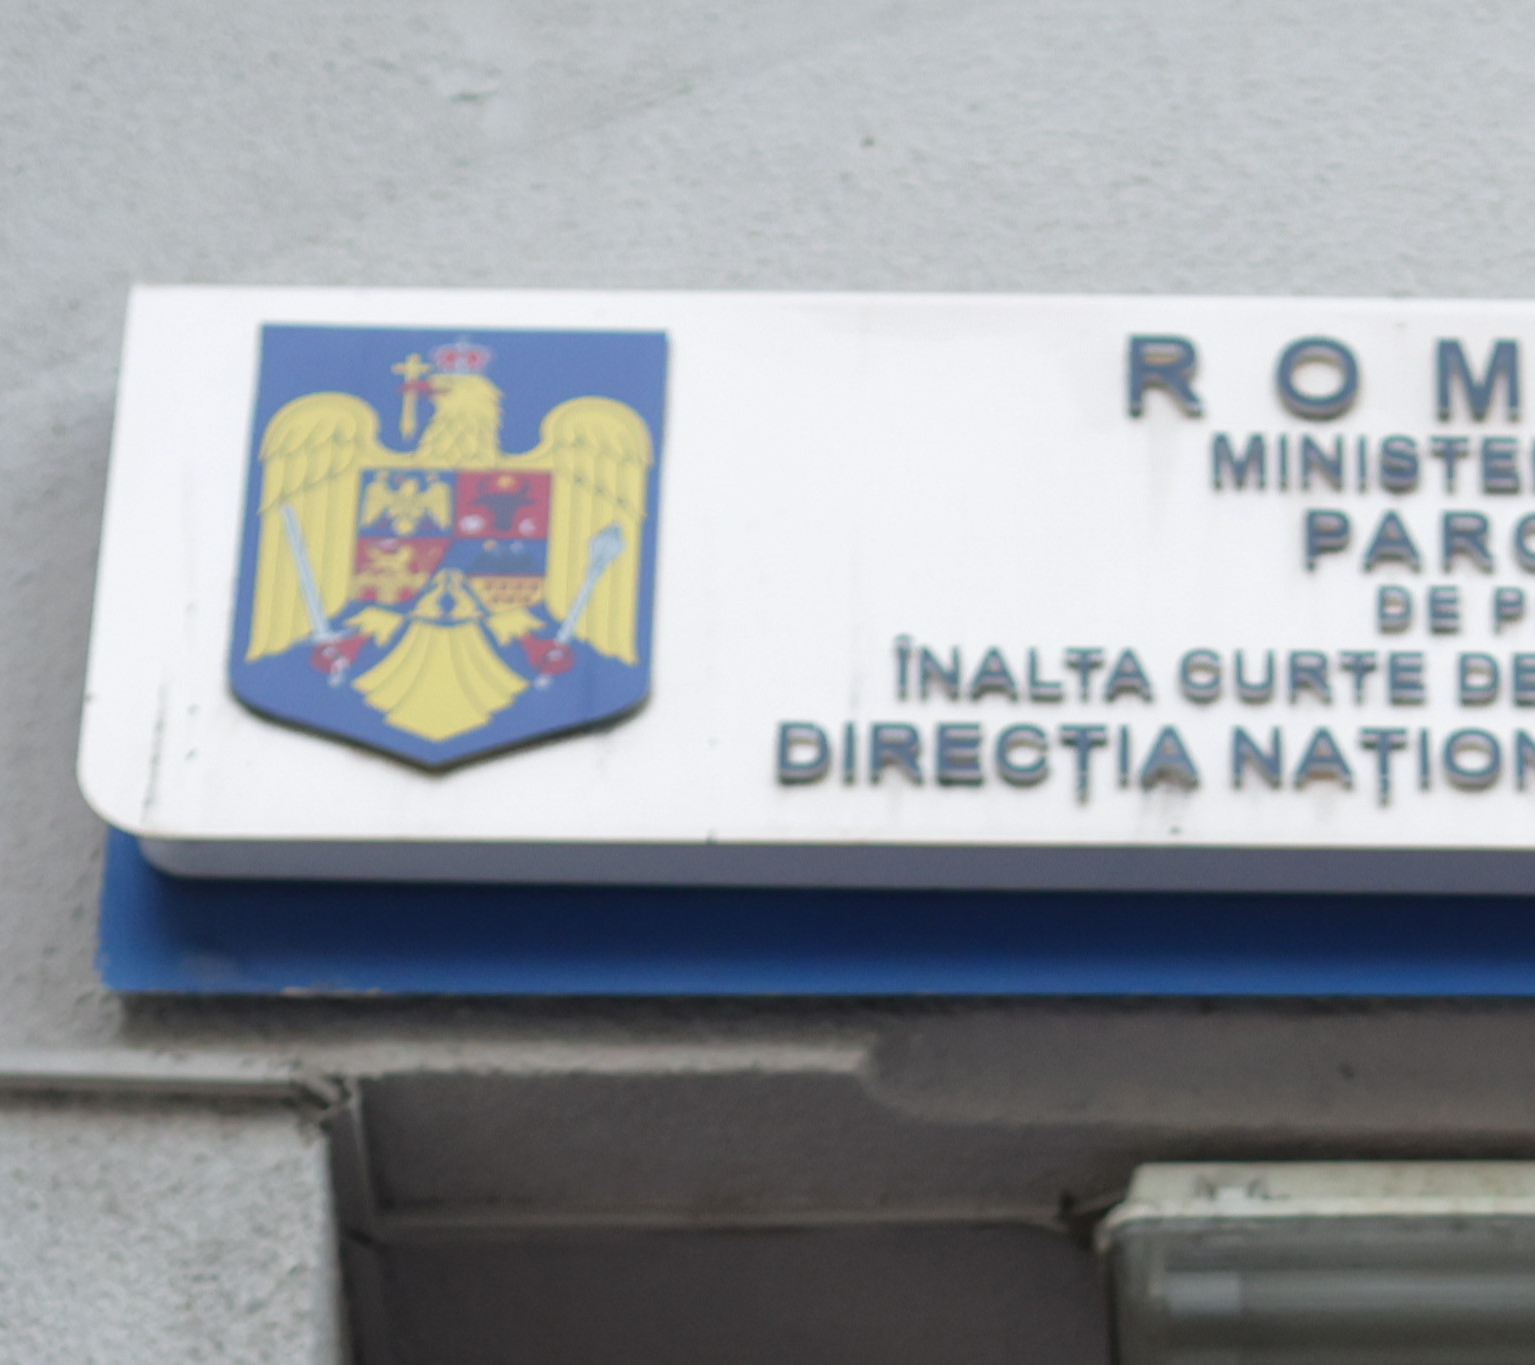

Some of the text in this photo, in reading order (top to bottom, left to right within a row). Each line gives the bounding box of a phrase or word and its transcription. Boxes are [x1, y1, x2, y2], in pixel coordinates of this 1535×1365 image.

[1376, 586, 1461, 636] DE
[894, 633, 1154, 705] ÎNALTA
[1179, 649, 1426, 707] CURTE
